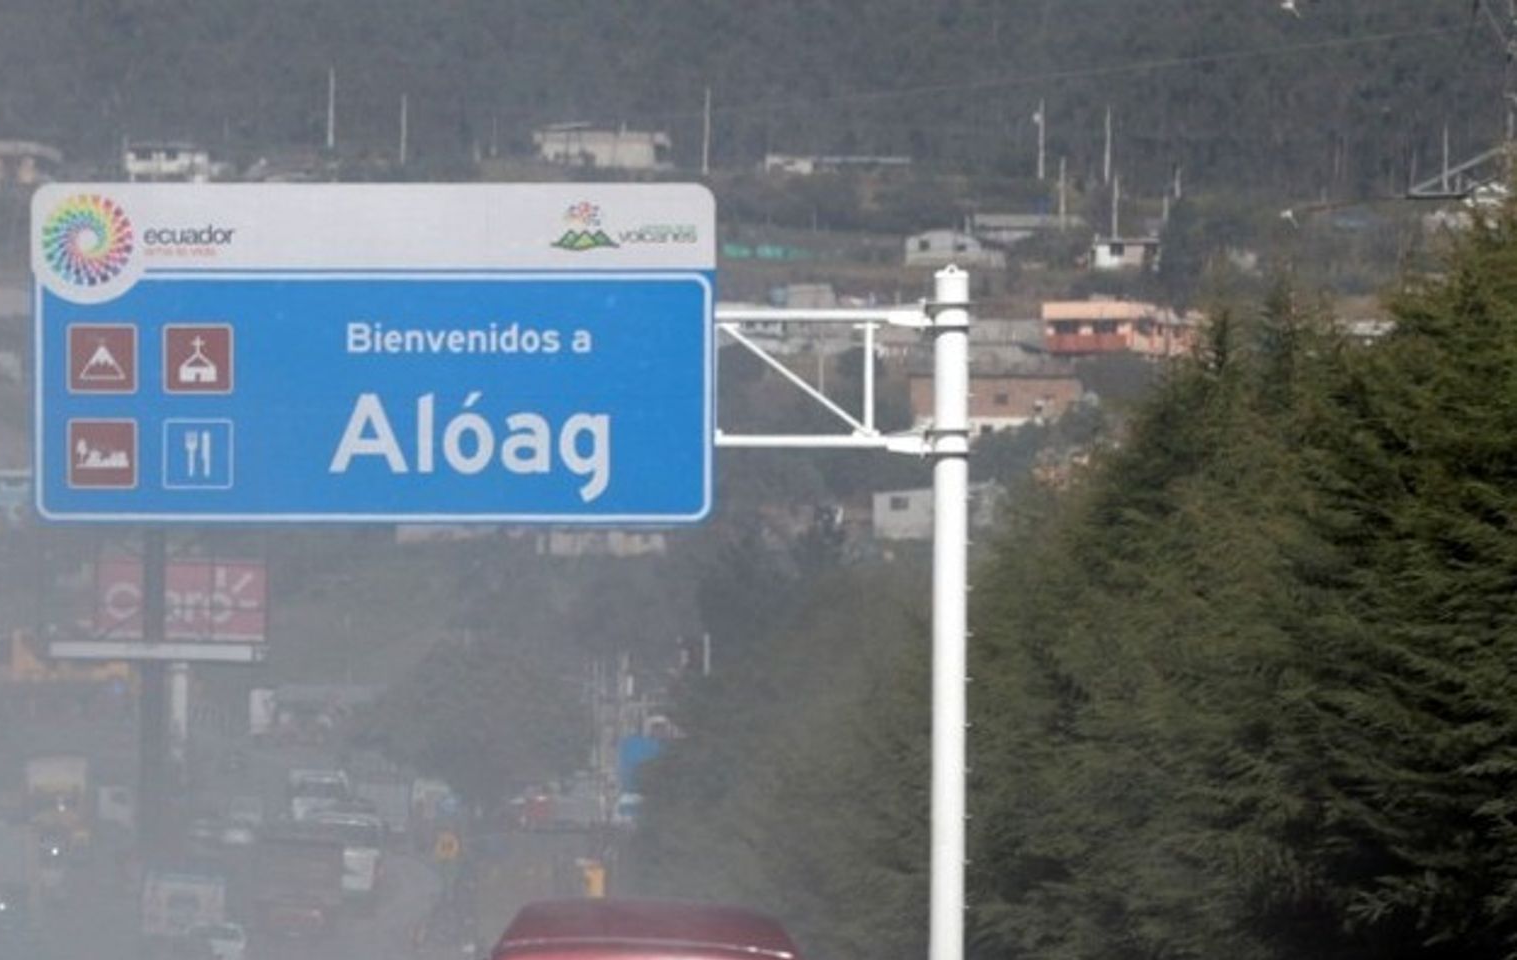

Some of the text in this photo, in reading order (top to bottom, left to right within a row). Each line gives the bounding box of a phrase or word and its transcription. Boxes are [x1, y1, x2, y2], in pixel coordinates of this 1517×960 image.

[143, 223, 235, 246] ecuador
[346, 323, 592, 354] Bienvenidos a
[328, 391, 611, 503] Alóag
